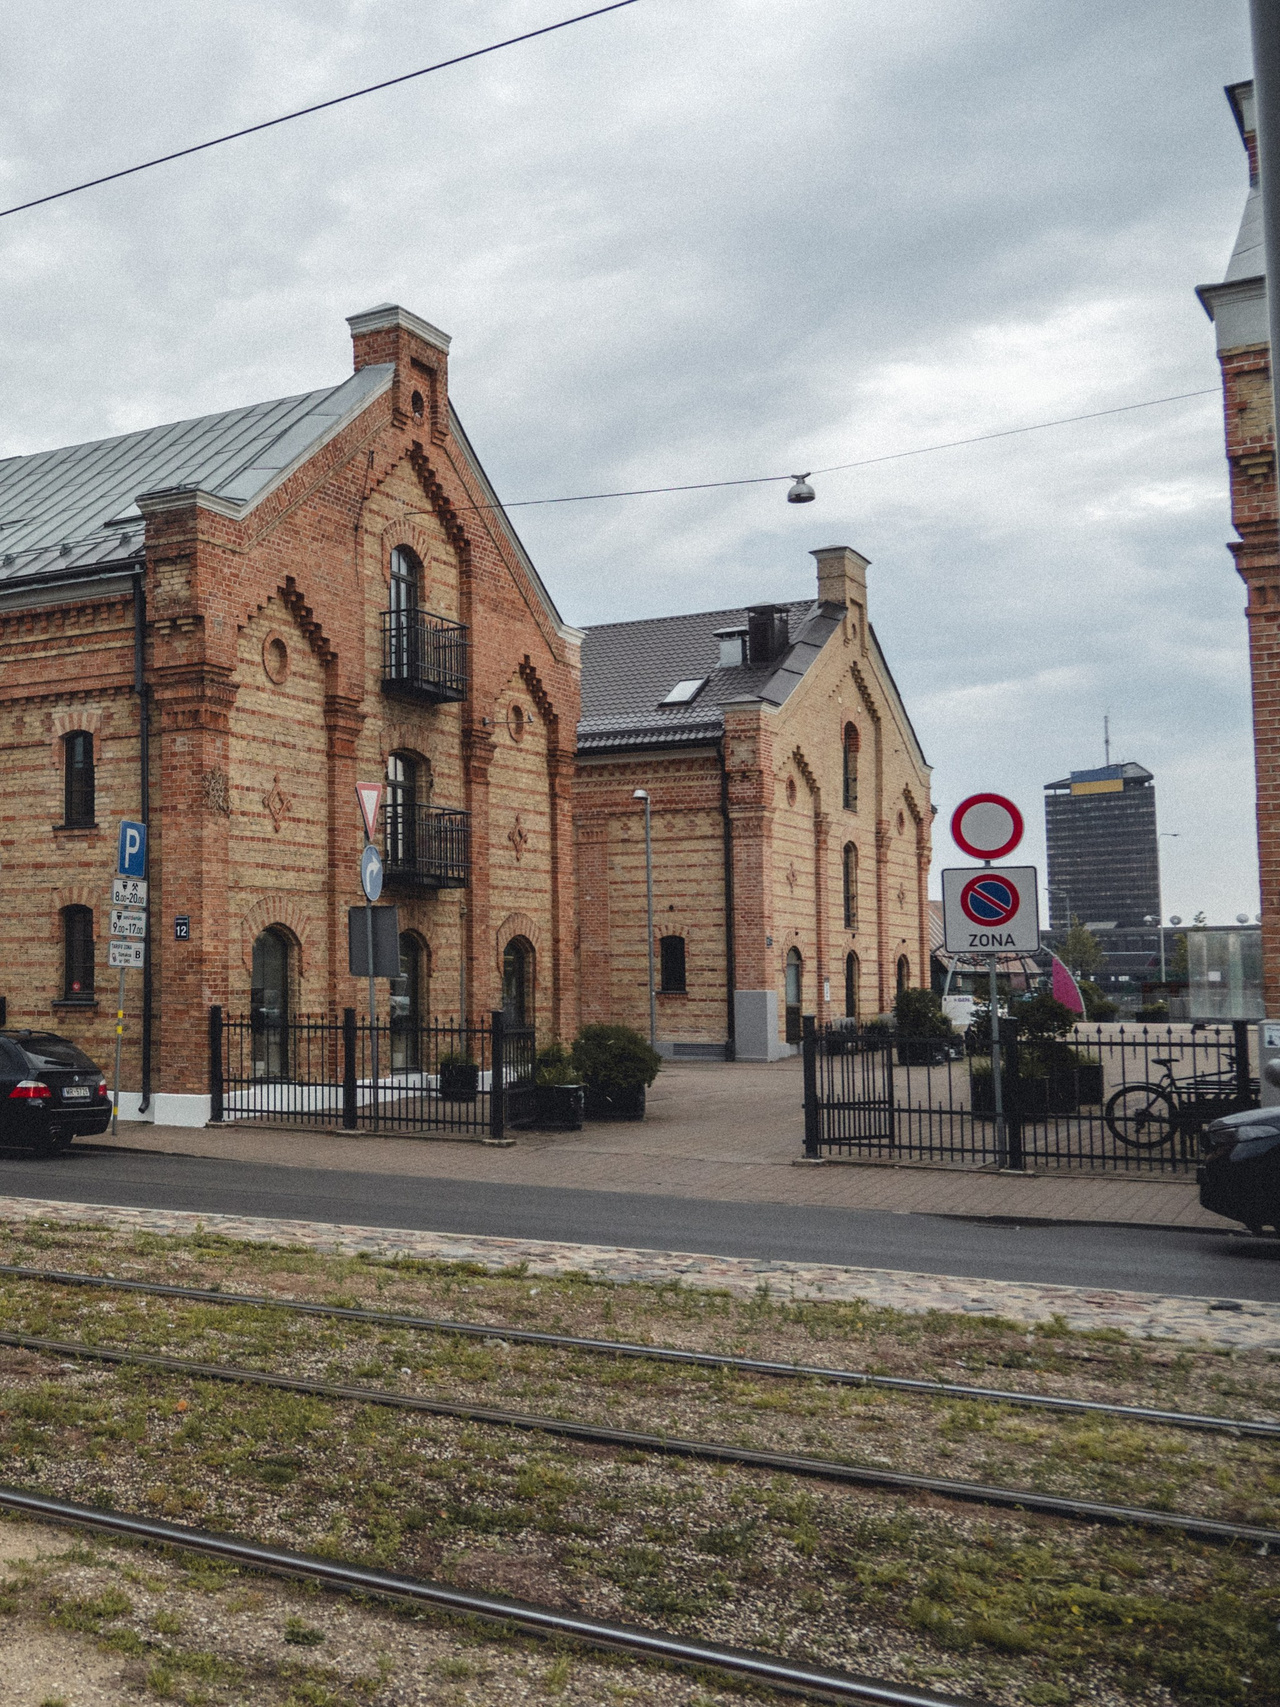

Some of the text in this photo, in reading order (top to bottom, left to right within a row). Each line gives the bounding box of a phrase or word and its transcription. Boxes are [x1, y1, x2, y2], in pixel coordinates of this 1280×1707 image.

[124, 828, 140, 868] P
[176, 926, 187, 936] 12
[968, 933, 1016, 947] ZONA
[135, 951, 141, 959] B
